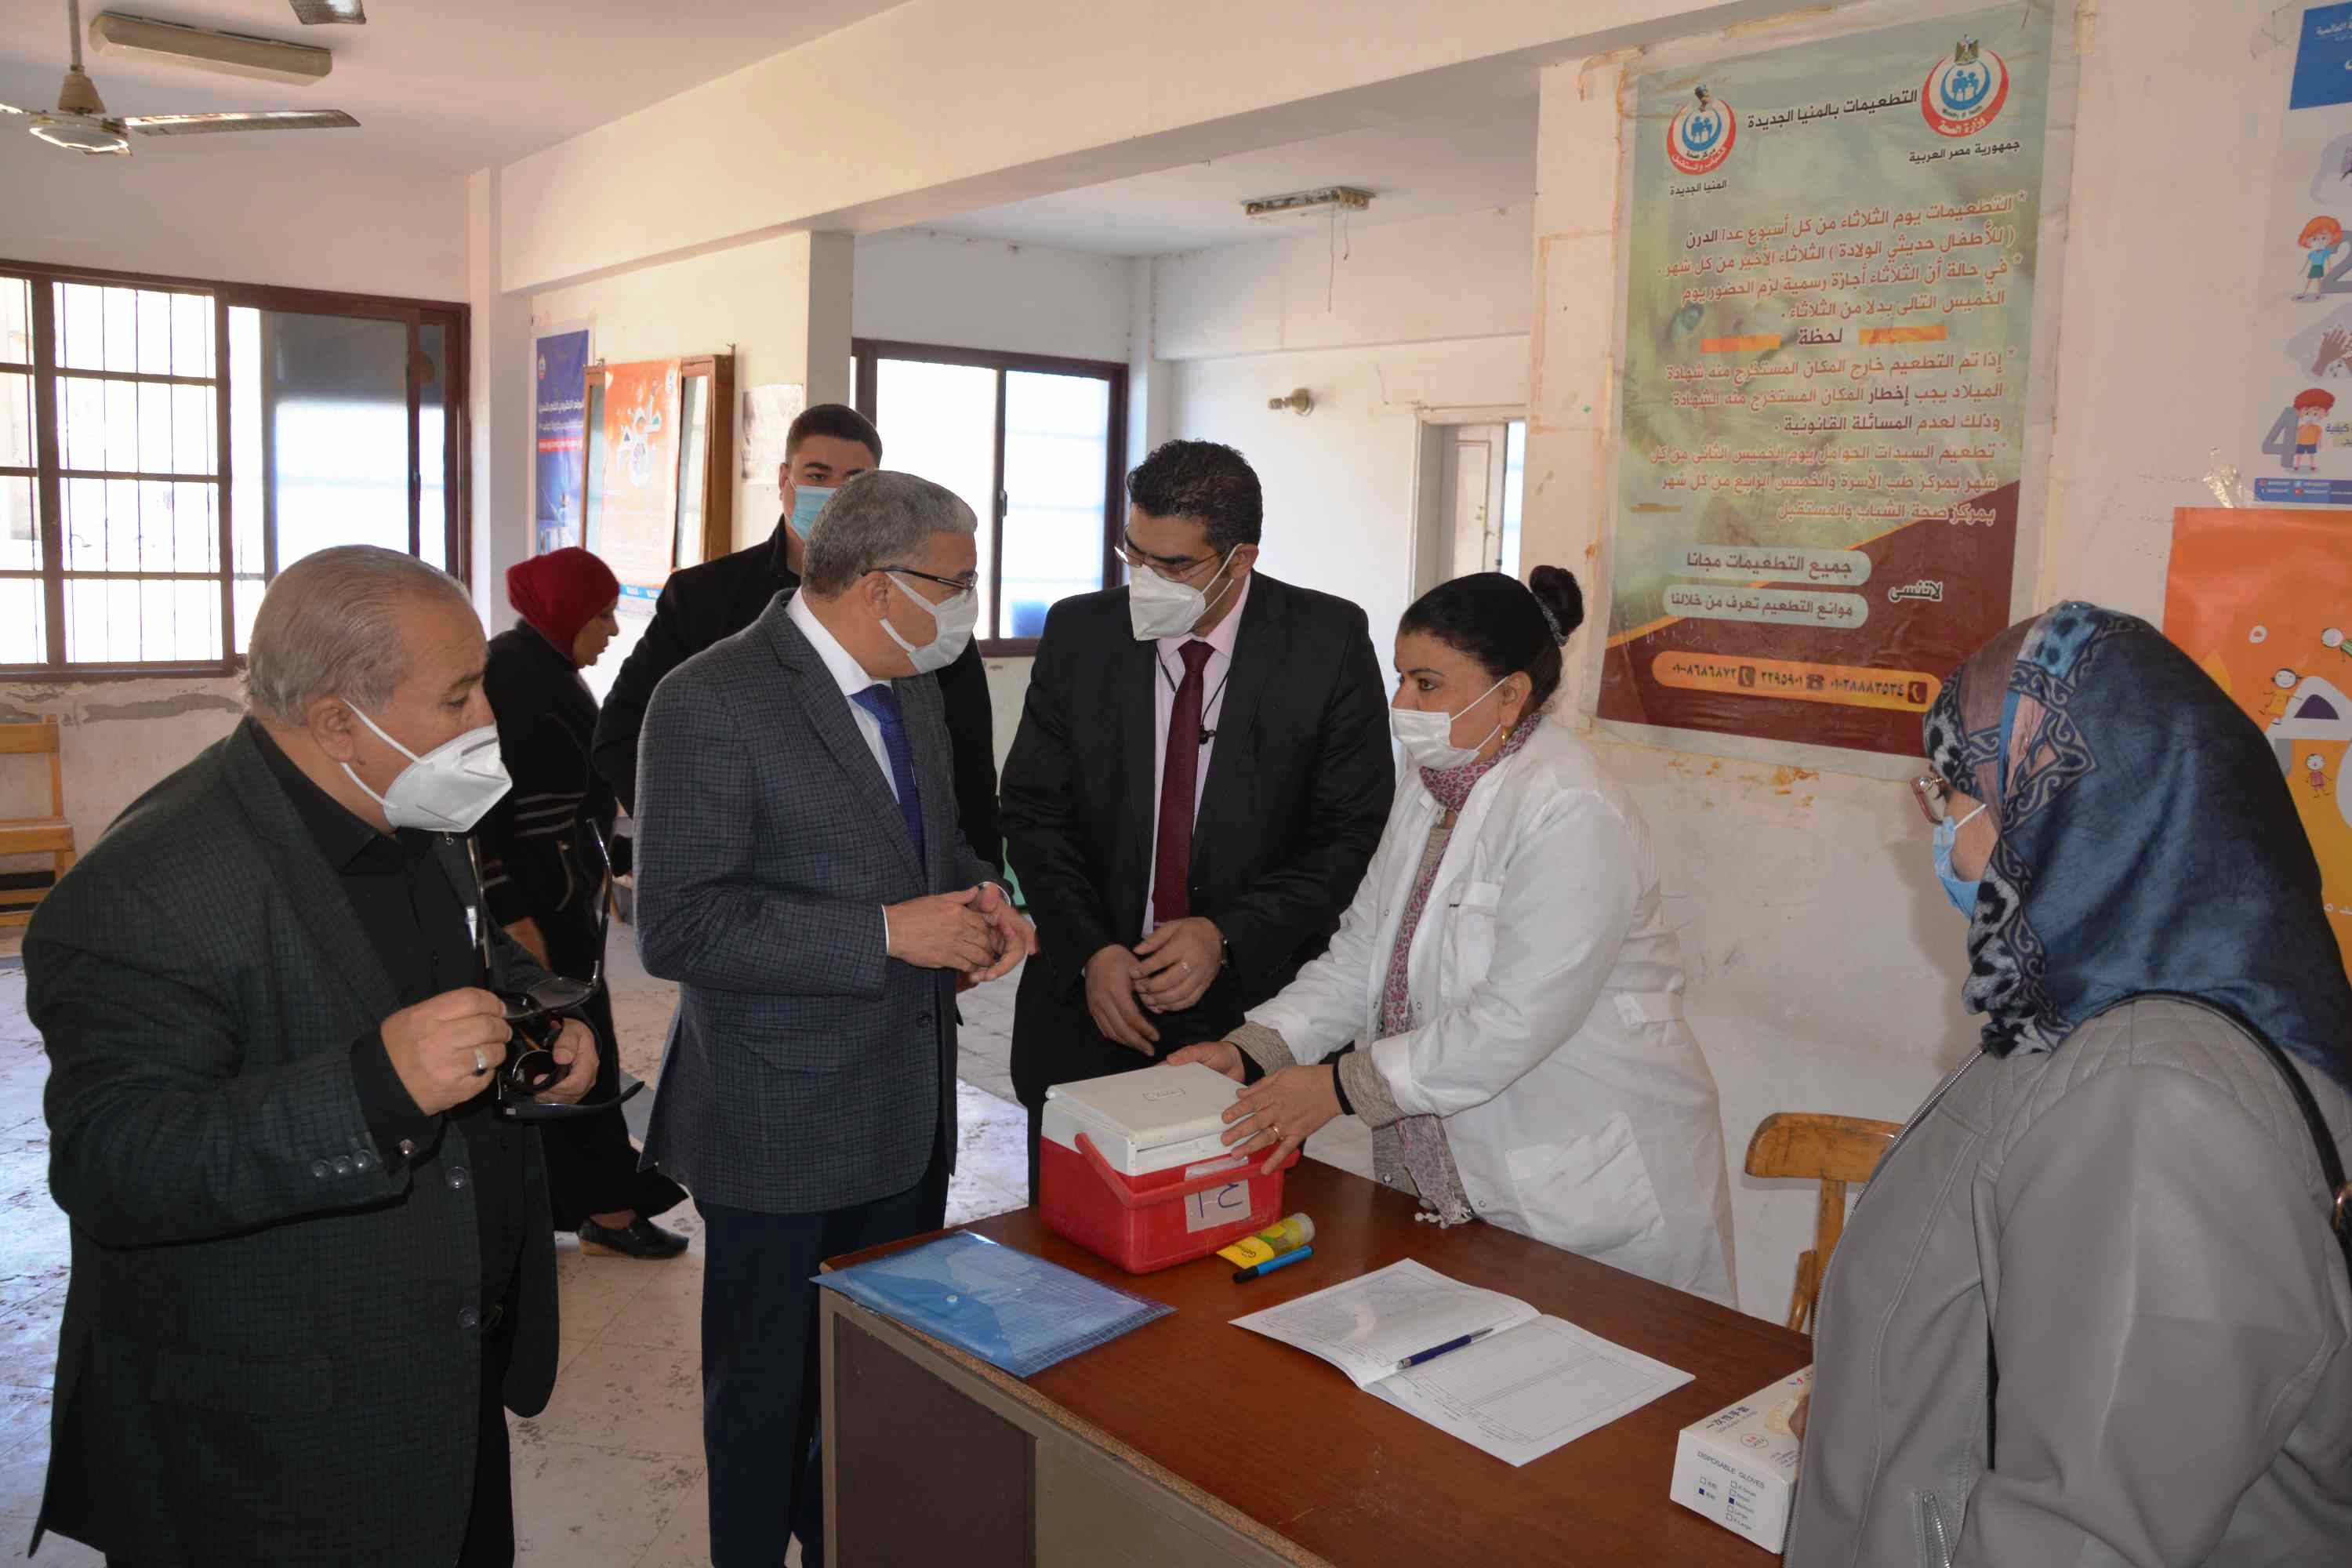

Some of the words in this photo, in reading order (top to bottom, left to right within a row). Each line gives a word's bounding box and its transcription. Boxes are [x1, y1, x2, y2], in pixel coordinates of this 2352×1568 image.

[1843, 89, 1917, 114] التطعيمات
[1748, 110, 1793, 130] الجديدة
[1797, 103, 1839, 124] بالمنيا
[1909, 149, 1945, 165] العربية
[1950, 147, 1970, 160] مصر
[1975, 140, 2020, 156] جمهورية
[1670, 183, 1700, 197] الجديدة
[1703, 180, 1727, 194] المنيا
[1840, 207, 1889, 228] الثلاثاء
[1926, 195, 2013, 221] التطعيمات
[1748, 213, 1788, 245] أسبوع
[1792, 218, 1811, 238] كل
[1816, 217, 1835, 235] من
[1893, 210, 1921, 230] يوم
[1686, 229, 1718, 249] الدرن
[1722, 228, 1744, 241] عدا
[1739, 245, 1775, 270] الأخير
[1779, 242, 1824, 263] الثلاثاء
[1888, 234, 1936, 263] حديثي
[1695, 256, 1713, 275] كل
[1716, 257, 1735, 274] من
[1870, 263, 1919, 284] الثلاثاء
[1924, 256, 1943, 285] أن
[1946, 260, 1979, 278] حالة
[1984, 257, 2008, 285] في
[1709, 279, 1754, 301] الحضور
[1757, 277, 1780, 300] لزم
[1784, 276, 1827, 296] رسمية
[1681, 289, 1705, 307] يوم
[1865, 298, 1893, 318] بدلا
[1942, 290, 2005, 314] الخميس
[1840, 301, 1861, 320] من
[1798, 328, 1843, 346] لحظة
[1667, 363, 1704, 383] شهادة
[1708, 364, 1731, 378] منه
[1733, 361, 1798, 385] المستخرج
[1803, 359, 1846, 379] المكان
[1849, 357, 1885, 379] خارج
[1889, 353, 1954, 376] التطعيم
[1673, 389, 1719, 409] الشهادة
[1725, 391, 1746, 405] منه
[1750, 390, 1816, 413] المستخرج
[1821, 387, 1864, 406] المكان
[1868, 385, 1910, 407] إخطار
[1914, 387, 1947, 405] يجب
[1951, 382, 2003, 403] الميلاد
[1851, 412, 1913, 431] المسائلة
[1916, 414, 1956, 436] لعدم
[1960, 412, 2001, 433] وذلك
[1650, 445, 1668, 464] كل
[1669, 447, 1688, 464] من
[1732, 445, 1784, 465] الخميس
[1787, 449, 1814, 466] يوم
[1818, 443, 1870, 465] الحوامل
[1875, 444, 1934, 463] السيدات
[1939, 442, 1996, 465] تطعيم
[1662, 472, 1686, 491] شهر
[1690, 473, 1708, 492] كل
[1711, 474, 1731, 491] من
[1734, 472, 1770, 495] الرابع
[1774, 470, 1835, 493] والخميس
[1841, 465, 1881, 492] الأسرة
[1886, 474, 1914, 494] طب
[1919, 473, 1960, 494] بمركز
[1965, 472, 1998, 494] شهر
[1777, 499, 1853, 523] والمستقبل
[1857, 499, 1907, 522] الشباب
[1911, 502, 1948, 521] صحة
[1949, 503, 1997, 527] بمركز
[1686, 551, 1722, 569] مجانا
[1726, 554, 1804, 575] التطعيمات
[1808, 557, 1852, 580] جميع
[1671, 594, 1702, 607] خلالنا
[1706, 595, 1723, 610] من
[1726, 596, 1760, 611] تعرف
[1762, 600, 1813, 615] التطعيم
[1817, 601, 1853, 620] موانع
[1697, 1450, 1736, 1475] DISPOSABLE
[1738, 1471, 1765, 1489] GLOVES
